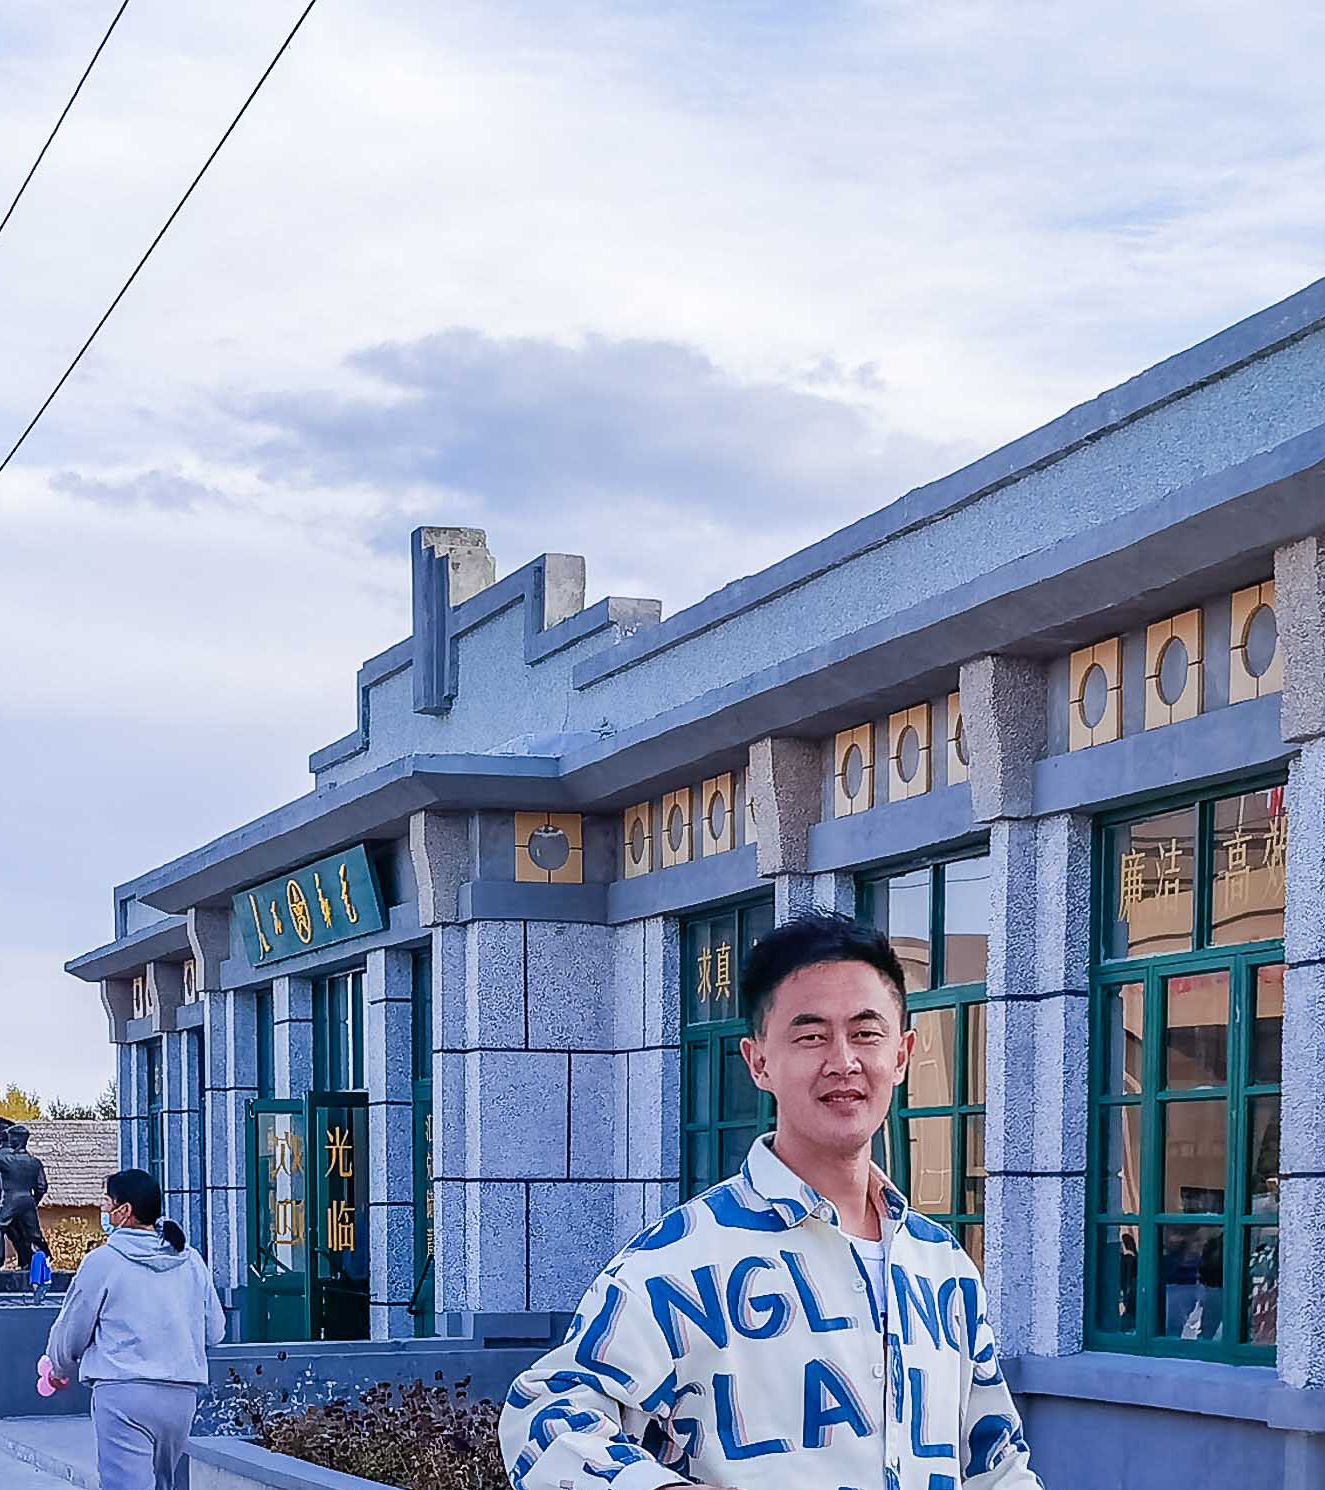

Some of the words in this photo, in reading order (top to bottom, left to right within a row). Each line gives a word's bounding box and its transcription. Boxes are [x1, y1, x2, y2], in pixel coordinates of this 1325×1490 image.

[1118, 838, 1183, 923] 廉洁
[697, 941, 731, 1003] 求真
[325, 1126, 356, 1252] 光临
